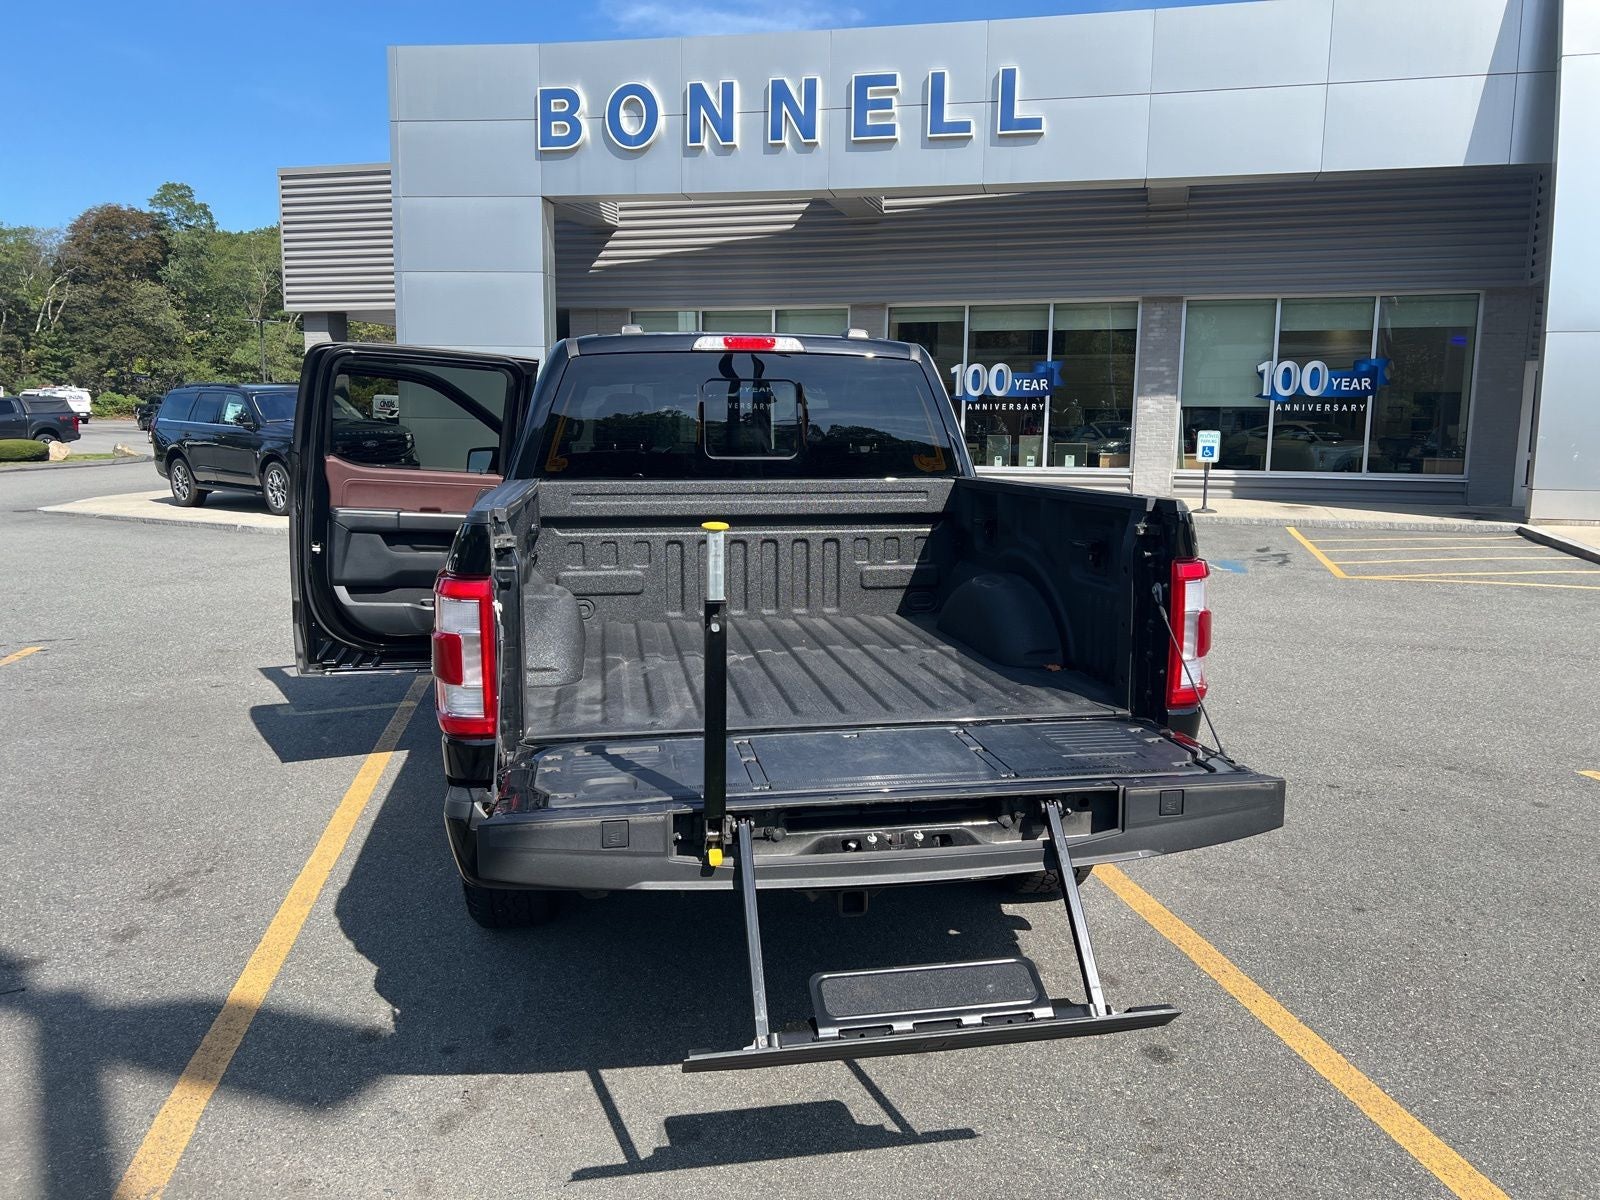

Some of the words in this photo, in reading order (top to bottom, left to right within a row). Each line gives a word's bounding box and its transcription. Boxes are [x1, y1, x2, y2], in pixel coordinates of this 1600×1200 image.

[537, 66, 1045, 151] BONNELL
[950, 362, 1013, 397] 100
[1014, 378, 1049, 391] YEAR
[1257, 360, 1329, 397] 100
[1331, 377, 1372, 391] YEAR
[967, 403, 1044, 411] ANNIVERSARY
[1275, 403, 1366, 412] ANNIVERSARY
